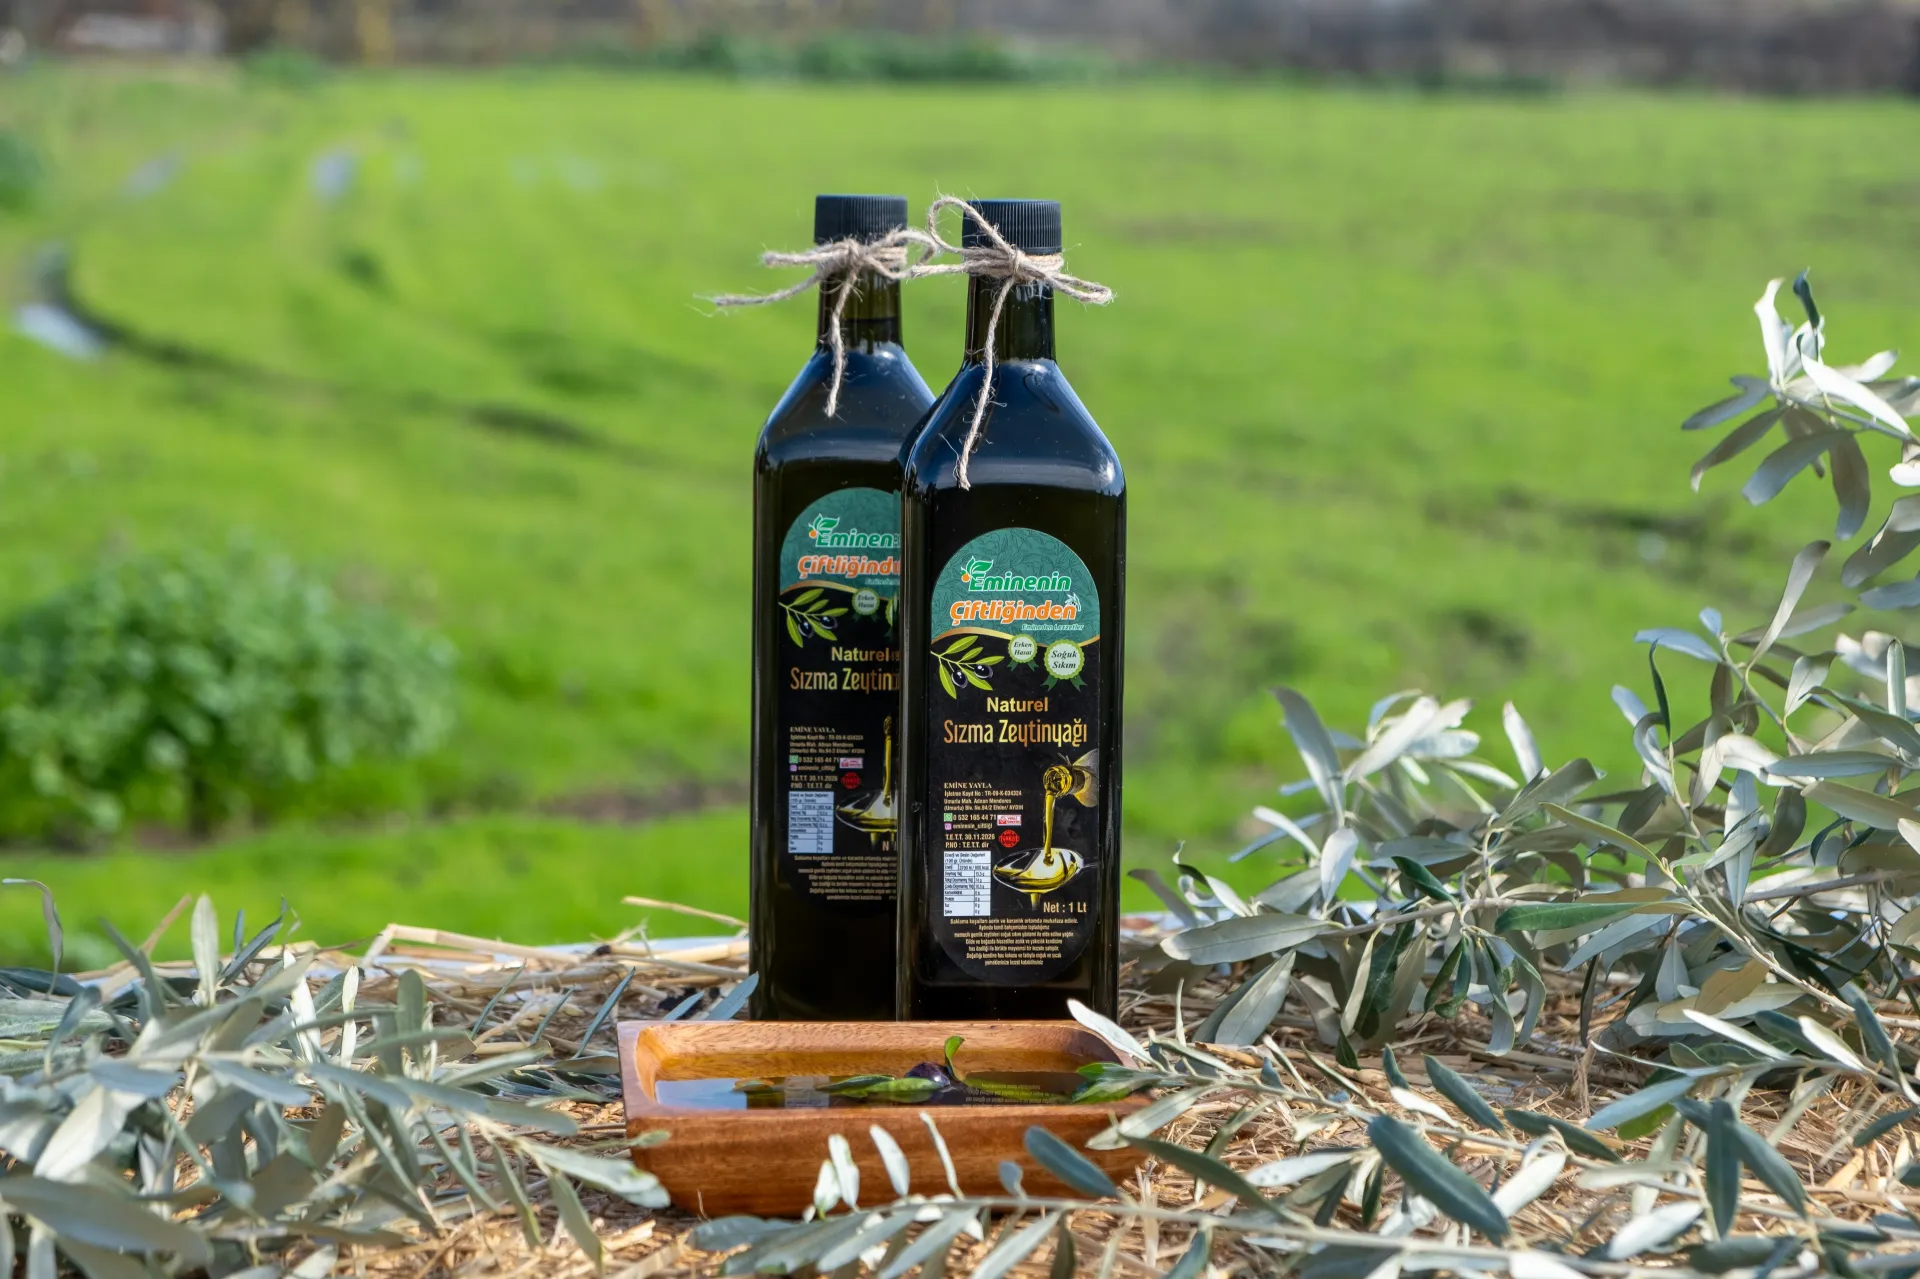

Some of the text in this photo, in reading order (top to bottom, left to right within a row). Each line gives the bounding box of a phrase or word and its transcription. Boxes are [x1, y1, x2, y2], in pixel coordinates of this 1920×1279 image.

[816, 528, 900, 548] Eminen
[798, 555, 900, 580] Çiftliğind
[968, 571, 1072, 592] Eminenin
[950, 600, 1077, 626] Çiftliğinden
[832, 647, 890, 662] Naturel
[1052, 650, 1077, 659] Soğuk
[790, 667, 900, 694] Sızma Zeytin
[987, 697, 1048, 712] Naturel
[944, 718, 1087, 747] Sızma Zeytinyağı
[1044, 902, 1059, 913] Net
[1069, 902, 1073, 913] 1
[1078, 902, 1087, 913] Lt
